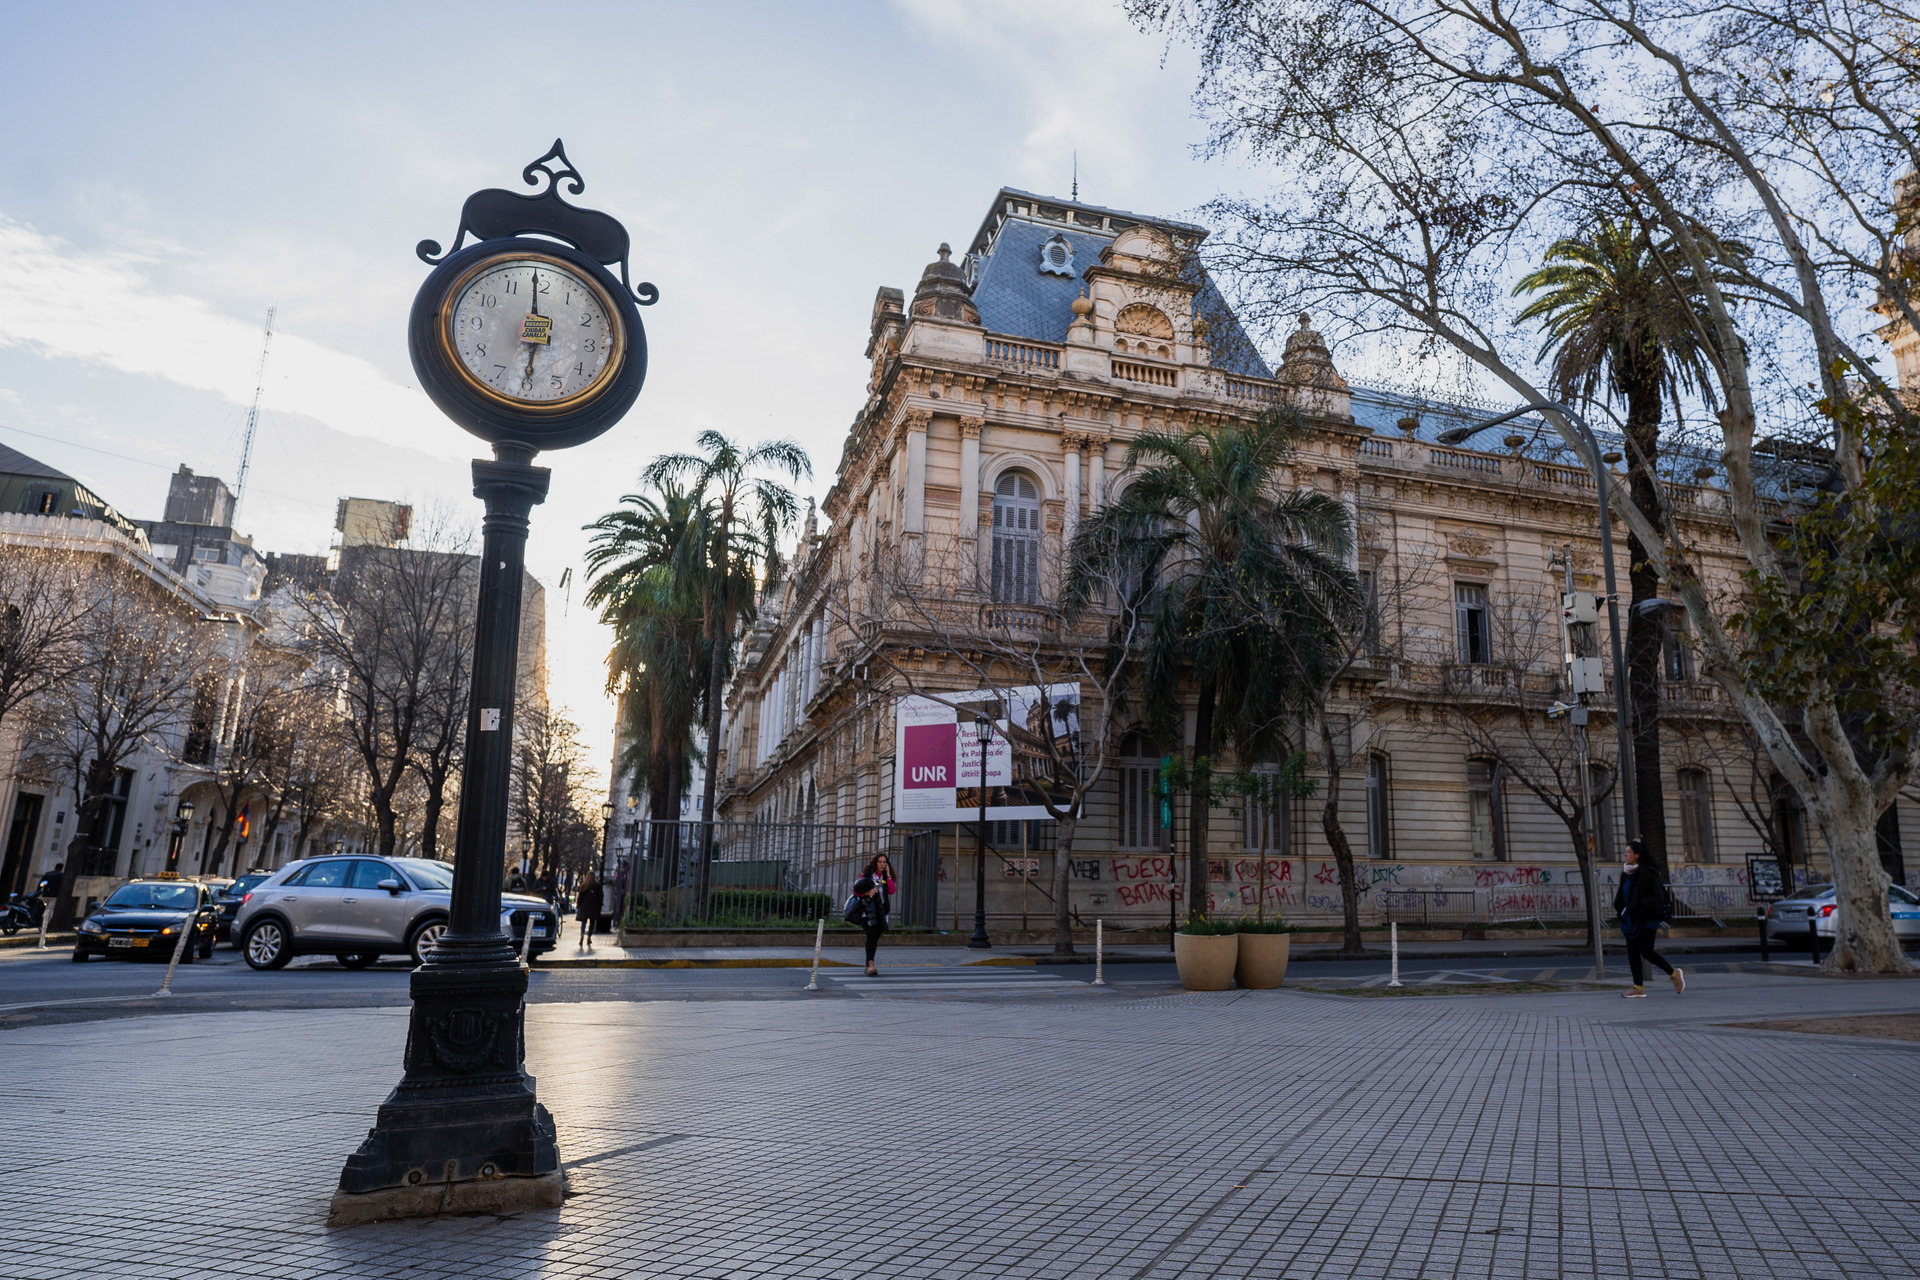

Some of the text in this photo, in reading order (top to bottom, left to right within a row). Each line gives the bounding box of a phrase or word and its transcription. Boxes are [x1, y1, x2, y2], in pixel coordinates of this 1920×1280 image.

[505, 280, 518, 295] 11
[480, 293, 497, 309] 10
[565, 292, 570, 305] 1
[470, 316, 483, 331] 9
[580, 312, 592, 327] 2
[474, 343, 487, 357] 8
[583, 338, 596, 353] 3
[493, 364, 507, 380] 7
[574, 362, 584, 376] 4
[521, 378, 533, 392] 6
[551, 375, 563, 389] 5
[994, 748, 1004, 756] de
[961, 759, 983, 768] Justici
[911, 765, 948, 783] UNR
[1109, 855, 1178, 881] FUERA
